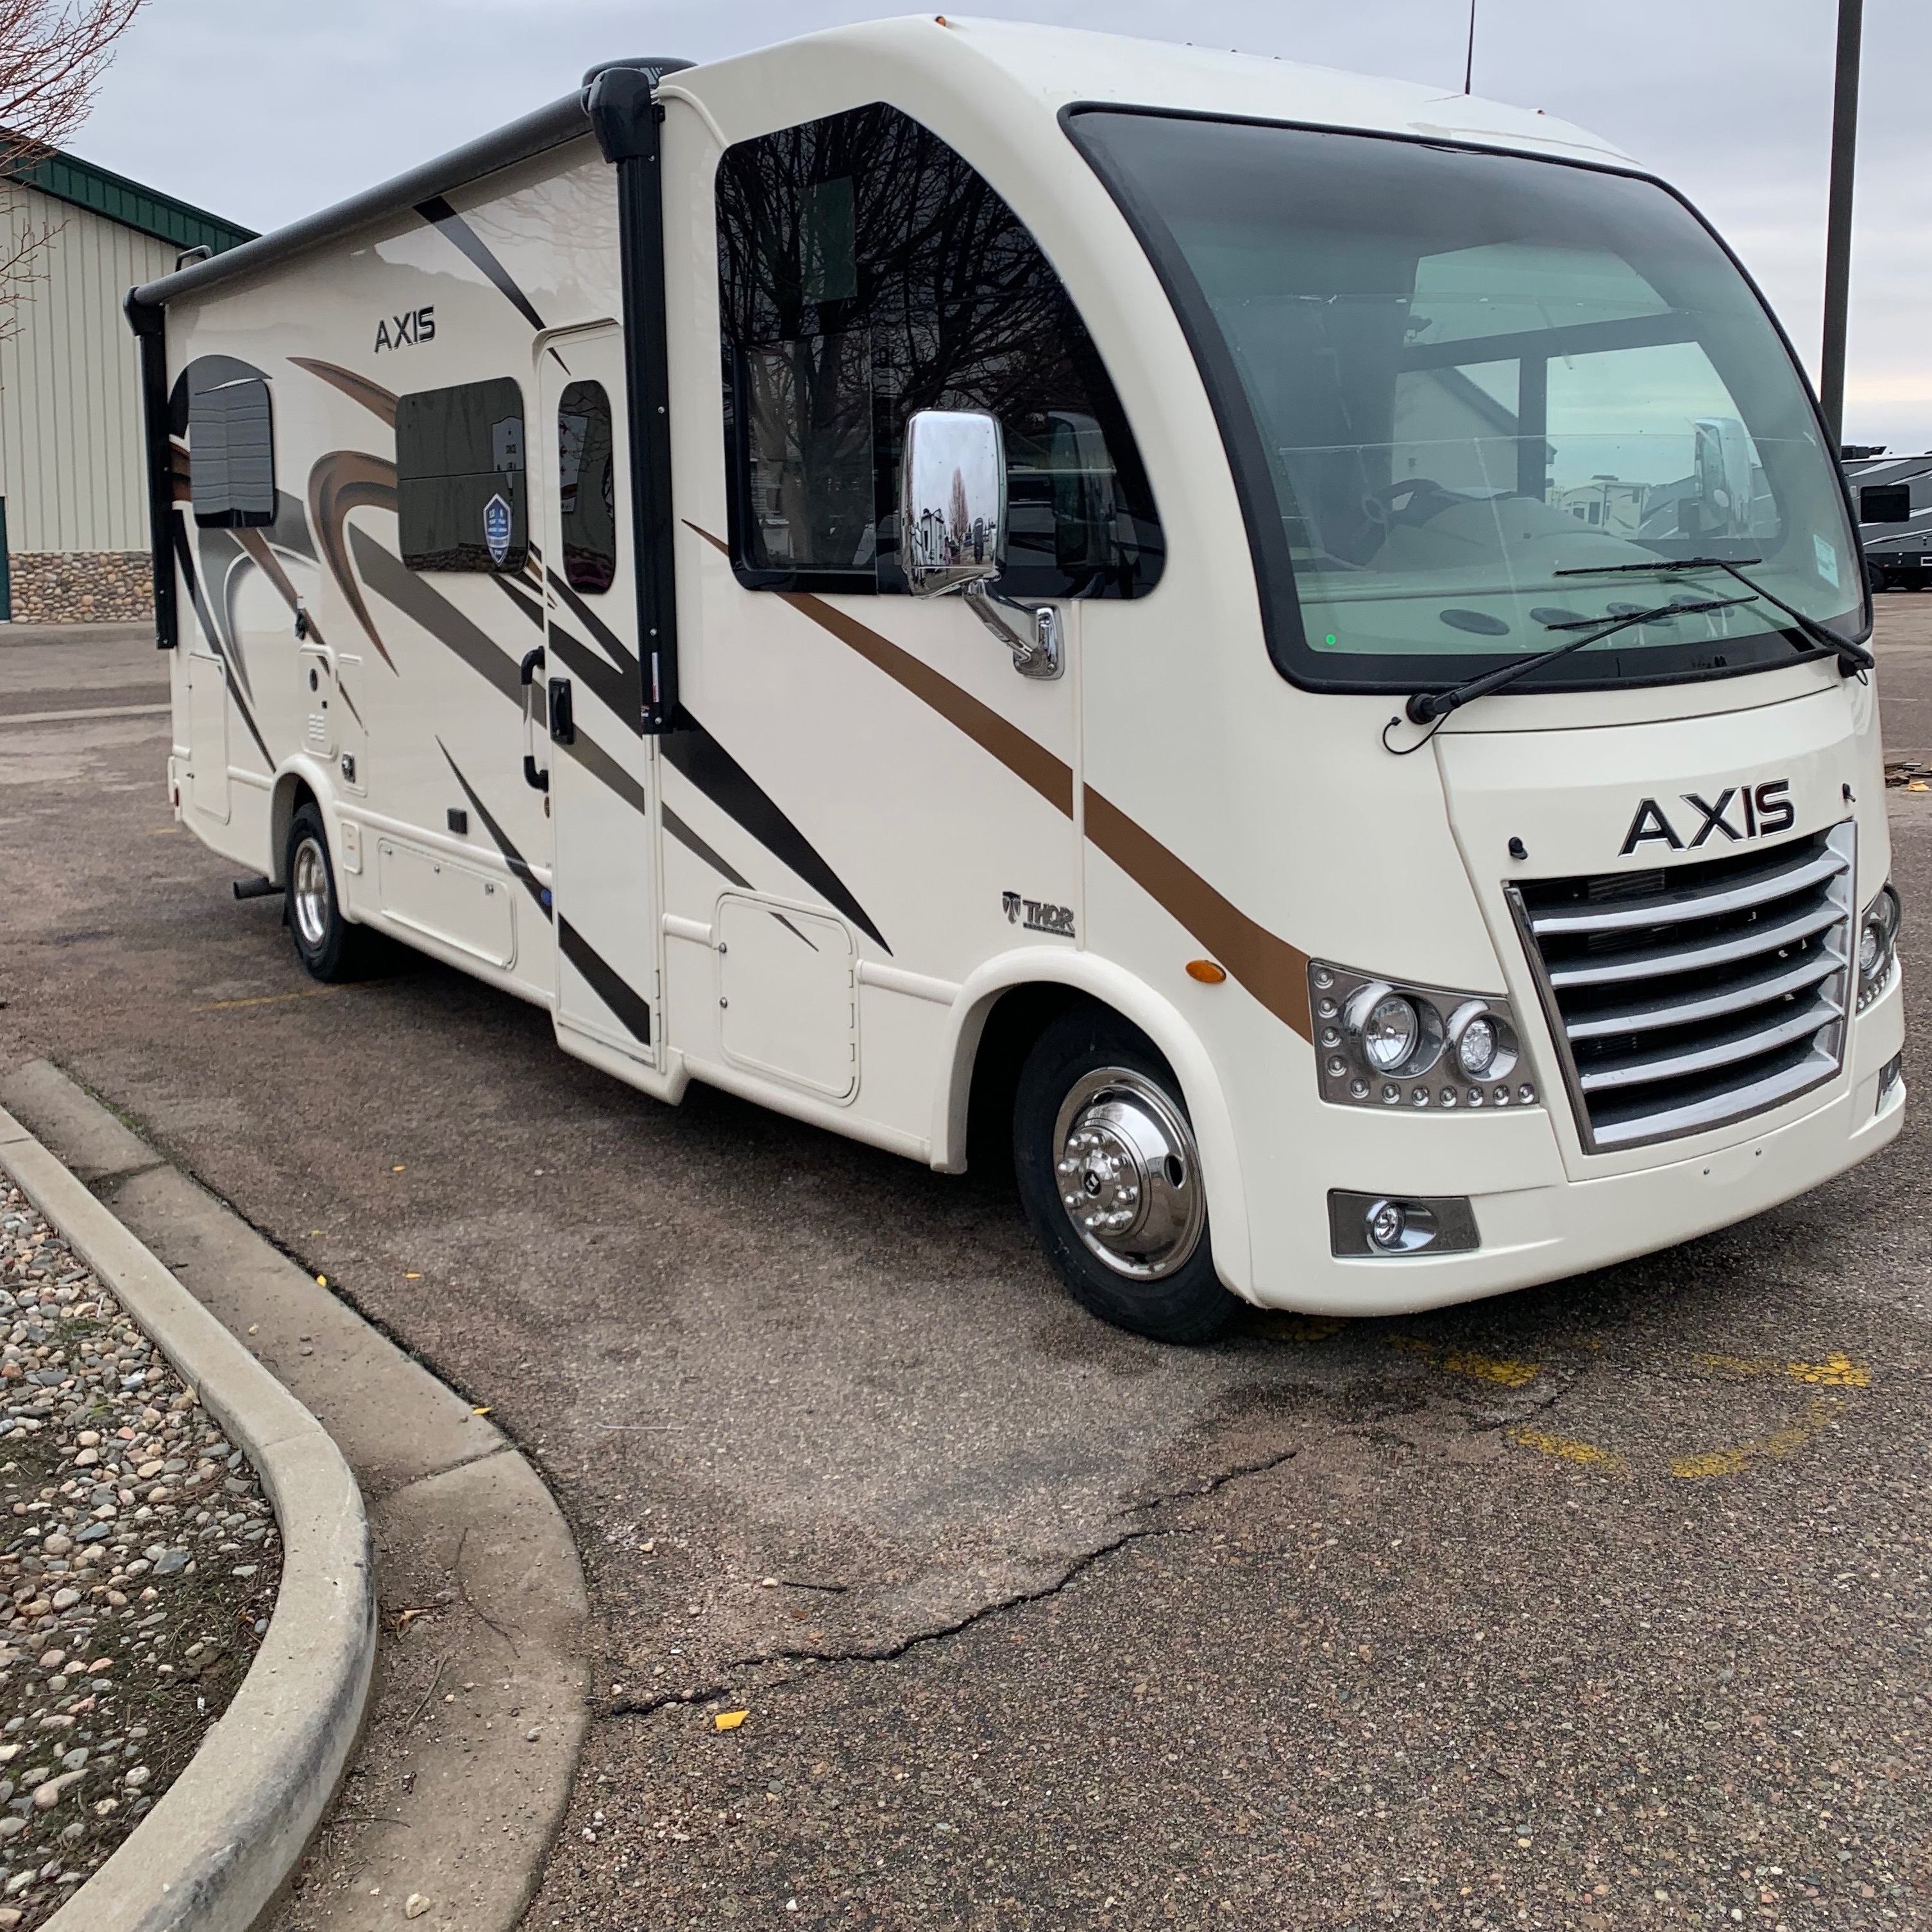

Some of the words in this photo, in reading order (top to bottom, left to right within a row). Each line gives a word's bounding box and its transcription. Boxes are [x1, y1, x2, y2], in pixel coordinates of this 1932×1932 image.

[373, 303, 436, 354] AXIS
[1618, 778, 1795, 858] AXIS
[1022, 899, 1076, 933] THOR
